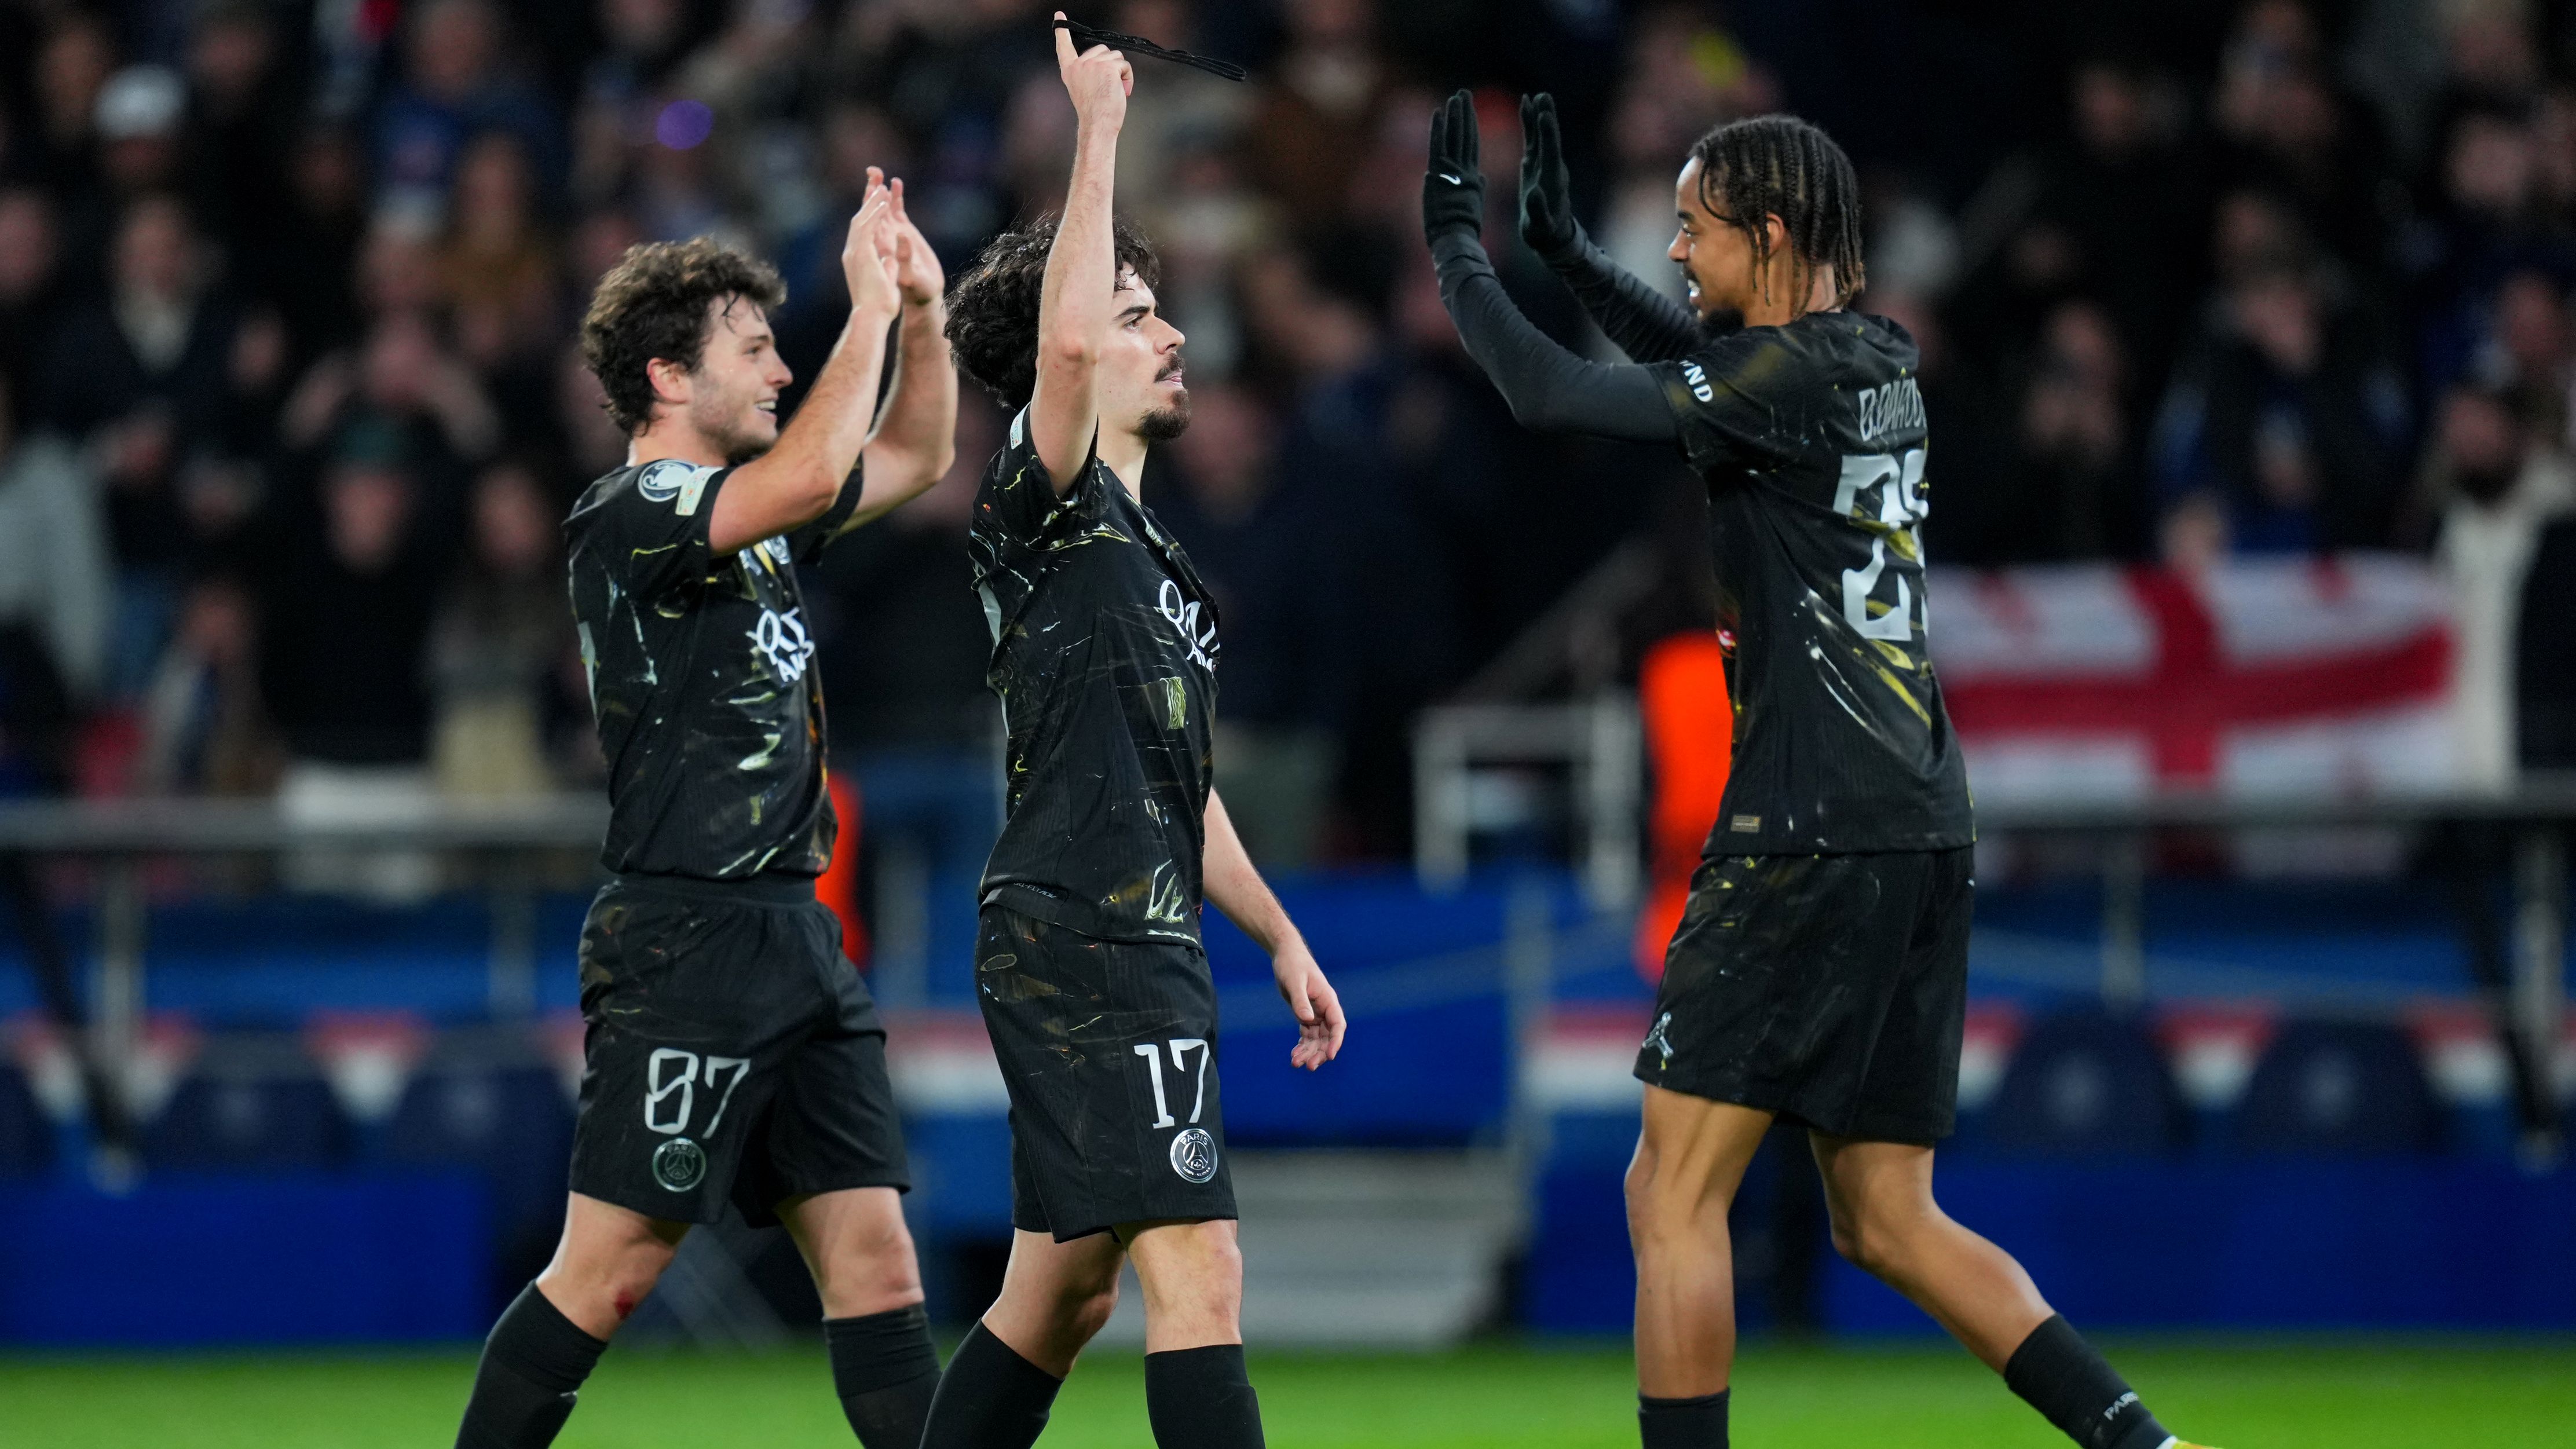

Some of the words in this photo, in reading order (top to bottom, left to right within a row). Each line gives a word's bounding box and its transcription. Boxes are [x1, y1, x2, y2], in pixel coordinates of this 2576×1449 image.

[645, 1048, 751, 1139] 87
[1133, 1039, 1210, 1129] 17
[1180, 1133, 1209, 1146] PARIS
